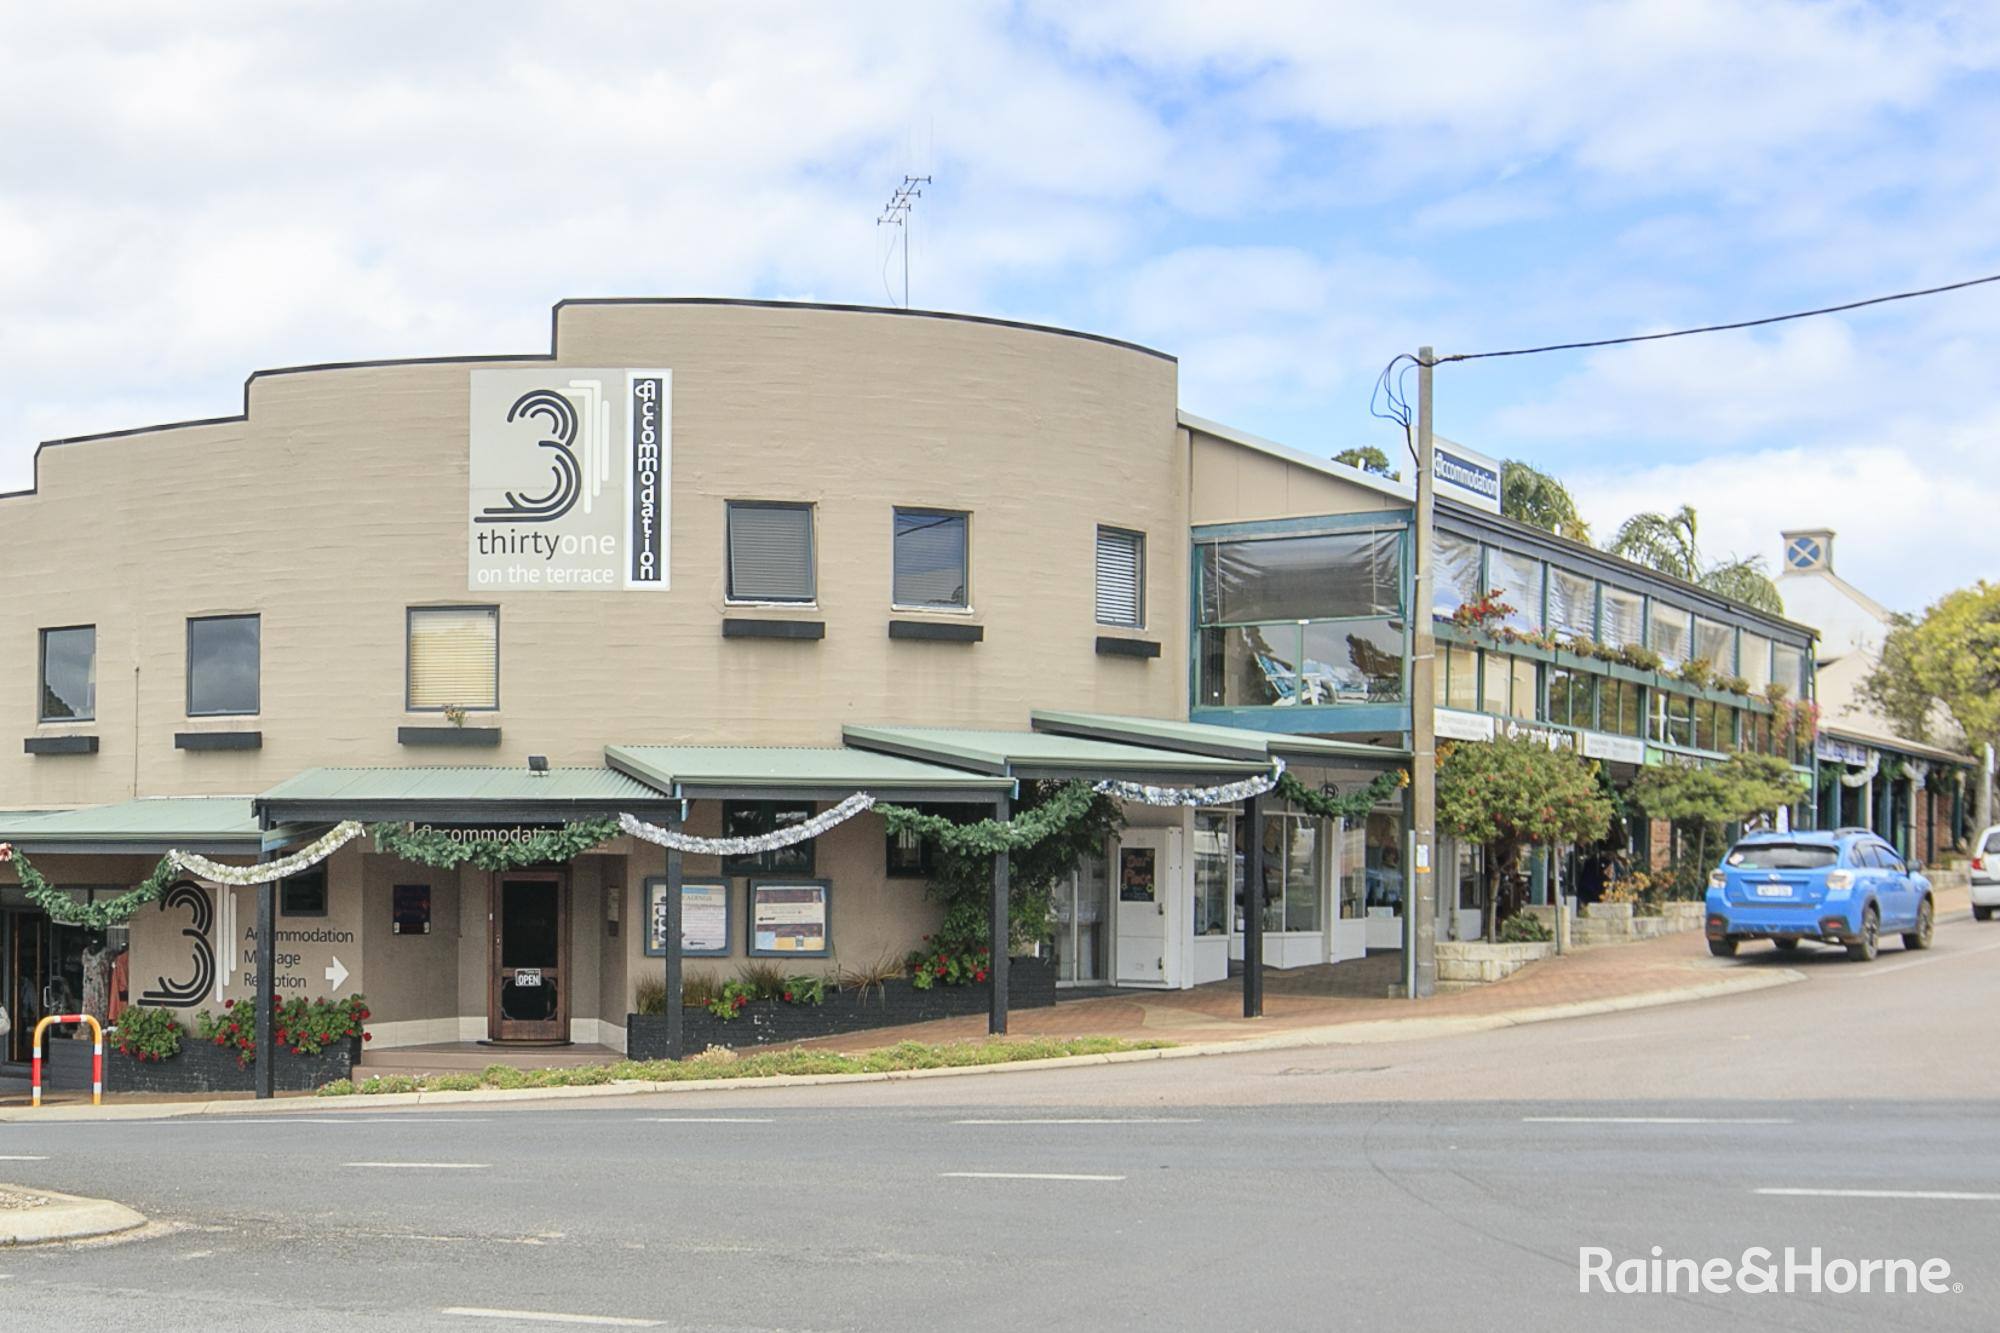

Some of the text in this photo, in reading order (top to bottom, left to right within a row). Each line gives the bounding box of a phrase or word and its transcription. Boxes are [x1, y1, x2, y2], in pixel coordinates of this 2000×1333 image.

[634, 380, 658, 580] Accommodation
[477, 528, 616, 560] thirtyone
[477, 564, 615, 583] on the terrace
[518, 974, 539, 986] OPEN
